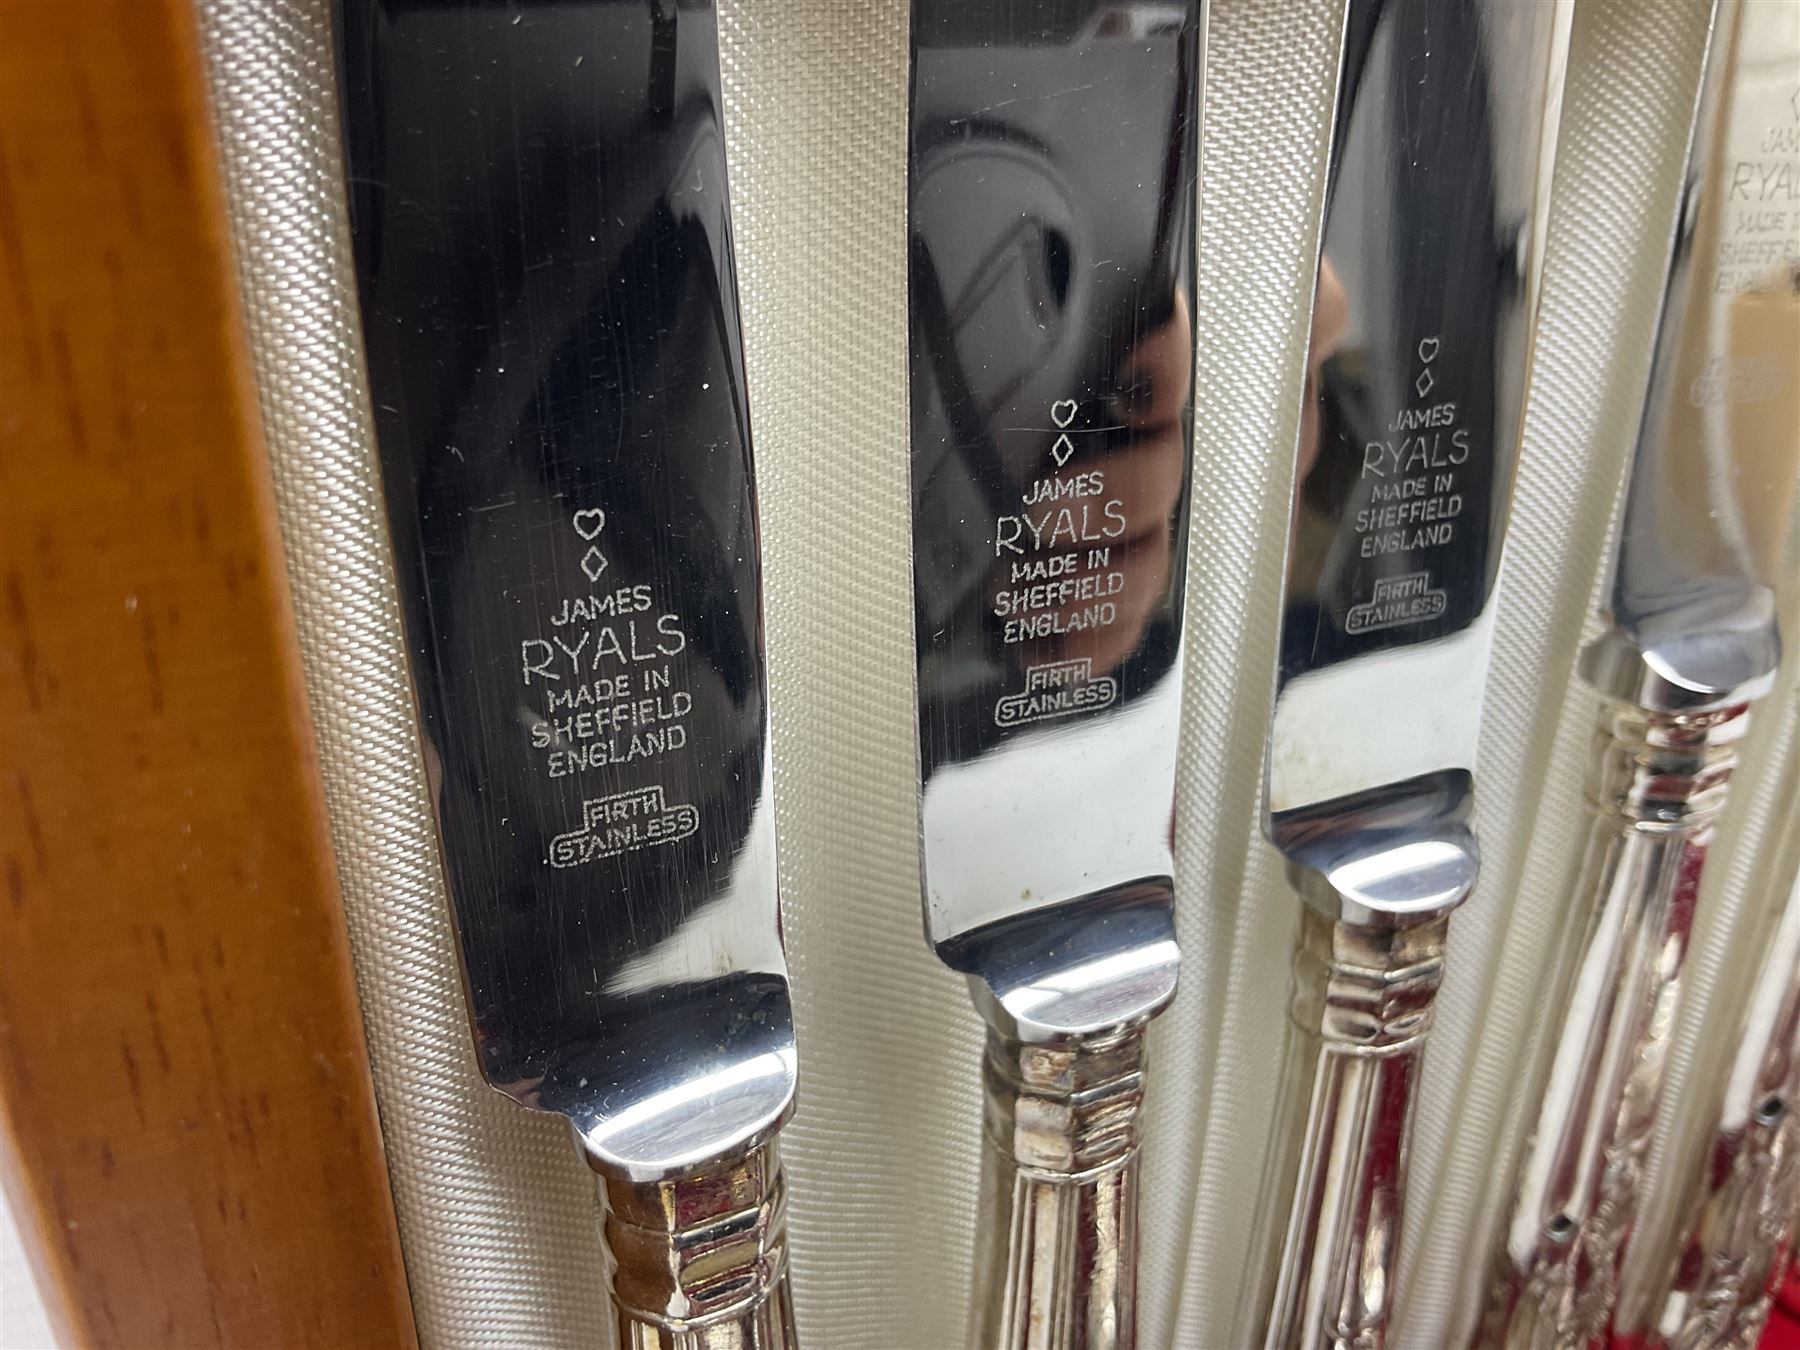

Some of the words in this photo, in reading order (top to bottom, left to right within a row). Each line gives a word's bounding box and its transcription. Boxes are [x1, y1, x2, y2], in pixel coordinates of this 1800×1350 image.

[1388, 404, 1455, 432] JAMES
[1362, 430, 1469, 479] RYALS
[1022, 471, 1104, 505] JAMES
[1371, 476, 1426, 503] MADE
[1434, 473, 1452, 493] IN
[995, 500, 1126, 557] RYALS
[1355, 494, 1462, 533] SHEFFIELD
[1361, 524, 1452, 558] ENGLAND
[1011, 553, 1077, 583] MADE
[1088, 548, 1110, 569] IN
[551, 585, 652, 626] JAMES
[994, 572, 1124, 616] SHEFFIELD
[1376, 578, 1424, 602] FIRTH
[1004, 602, 1116, 643] ENGLAND
[1350, 594, 1442, 628] STAINLESS
[521, 614, 686, 685] RYALS
[546, 675, 631, 713] MADE
[644, 665, 670, 691] IN
[1031, 662, 1086, 690] FIRTH
[532, 691, 692, 748] SHEFFIELD
[1000, 682, 1111, 720] STAINLESS
[548, 724, 687, 777] ENGLAND
[591, 793, 658, 827] FIRTH
[556, 809, 693, 861] STAINLESS
